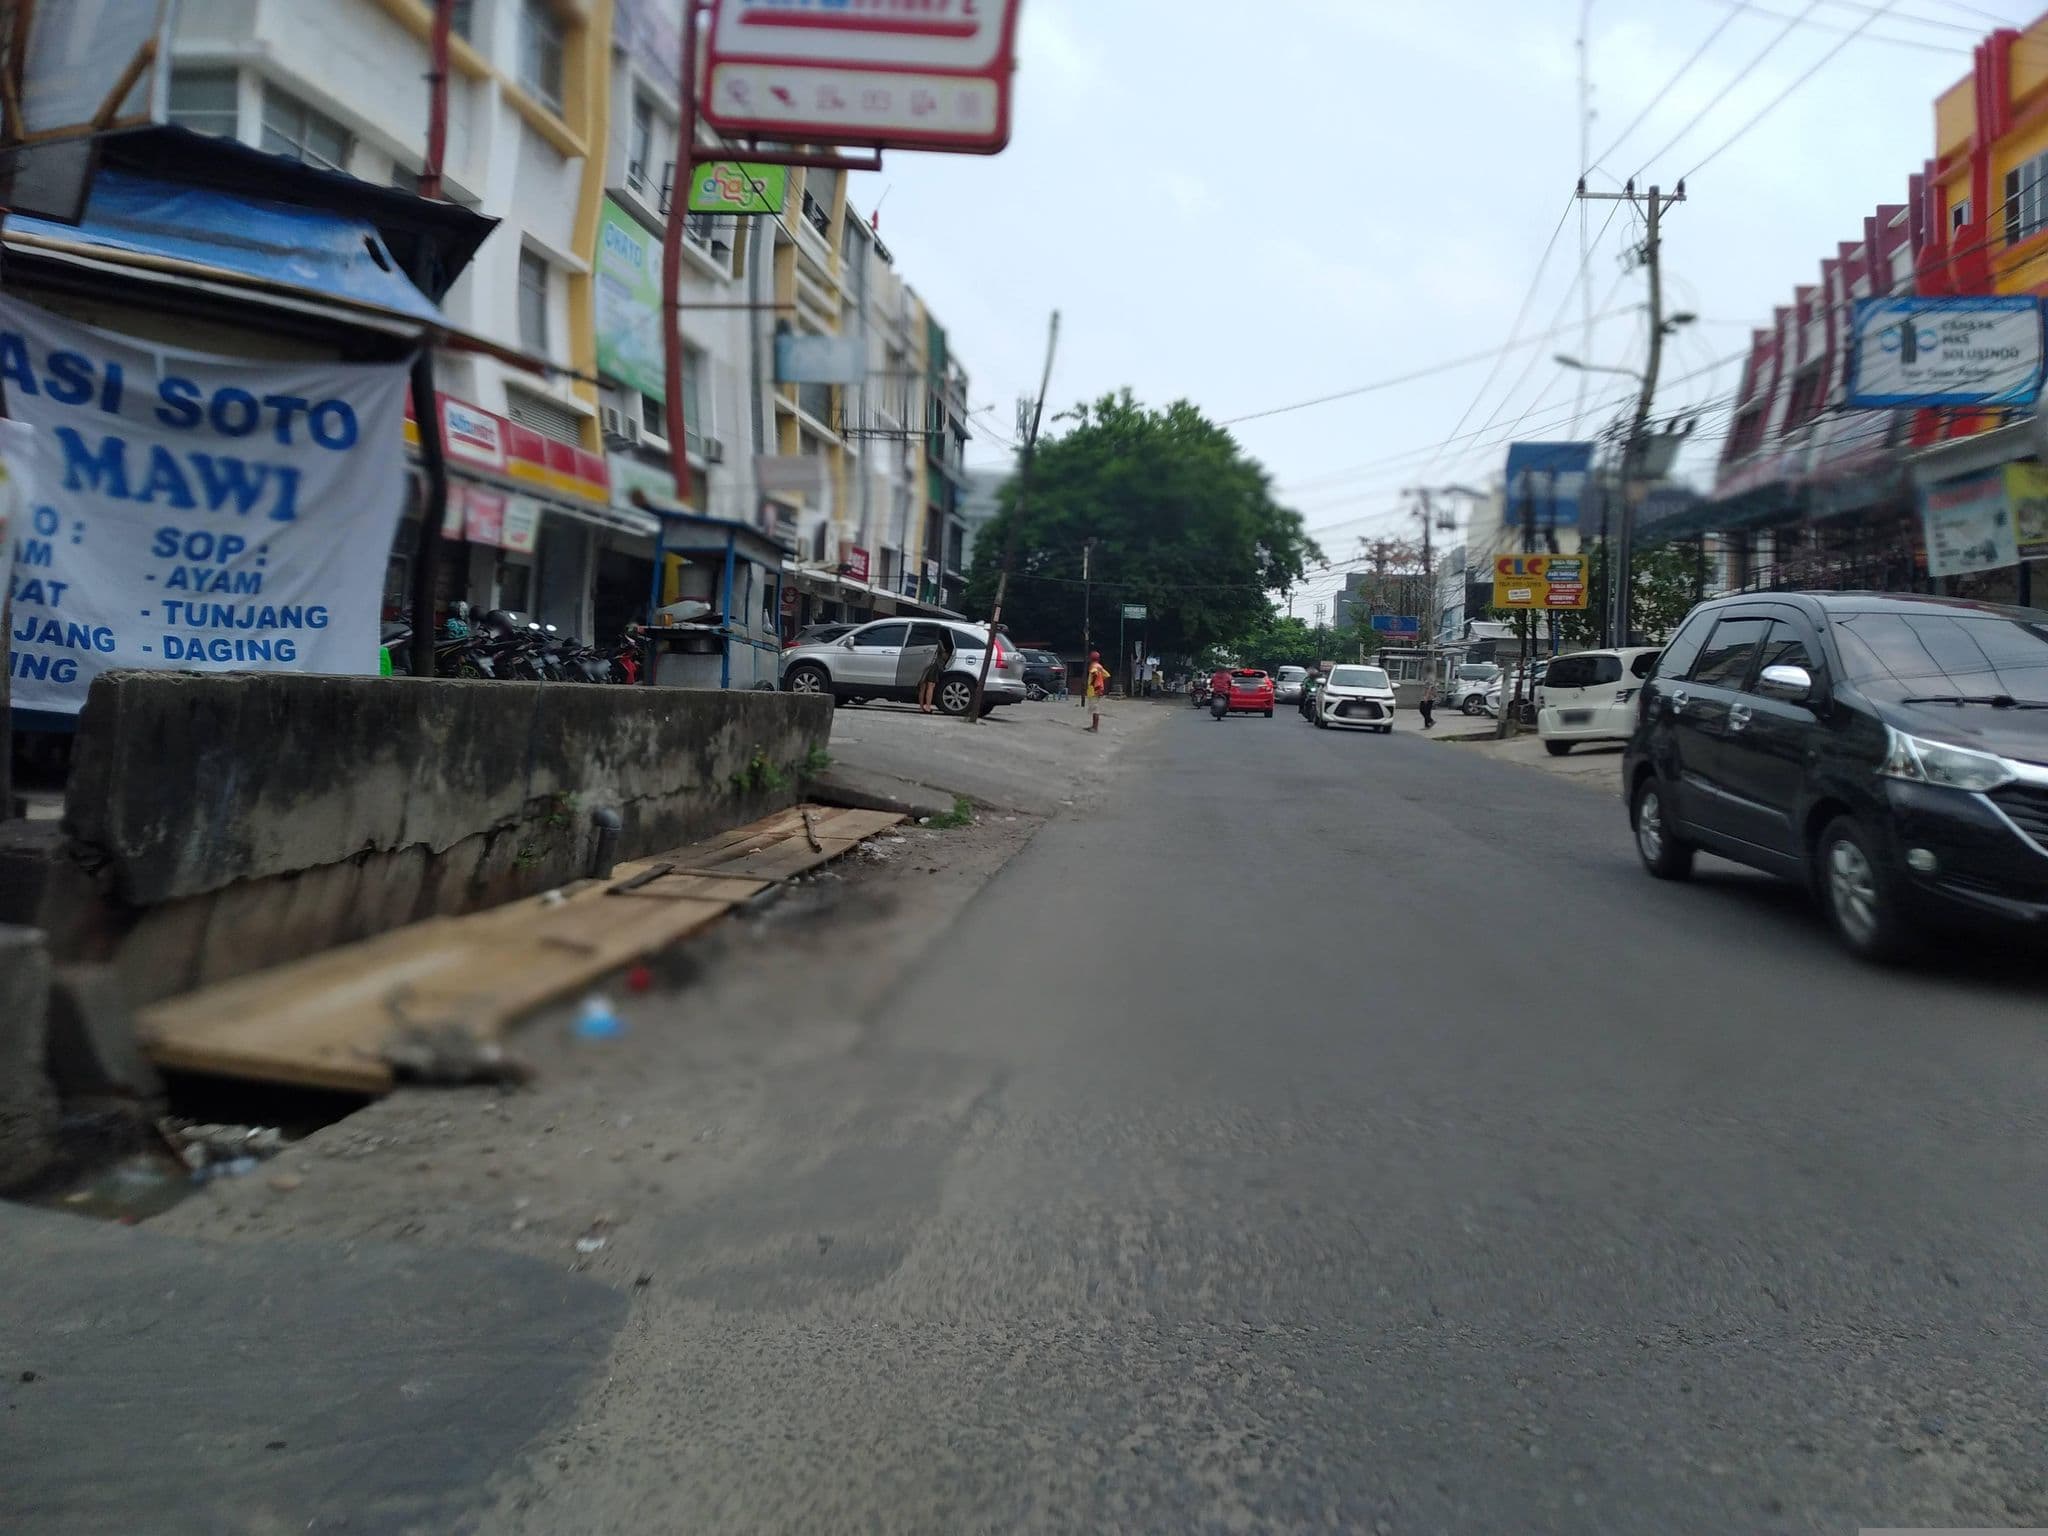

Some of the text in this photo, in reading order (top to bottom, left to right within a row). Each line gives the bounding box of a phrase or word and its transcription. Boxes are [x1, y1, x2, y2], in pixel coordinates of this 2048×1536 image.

[153, 374, 360, 453] SOTO
[54, 426, 301, 521] MAWI
[164, 565, 263, 596] AYAM
[161, 600, 330, 631] TUNJANG
[162, 635, 297, 663] DAGING
